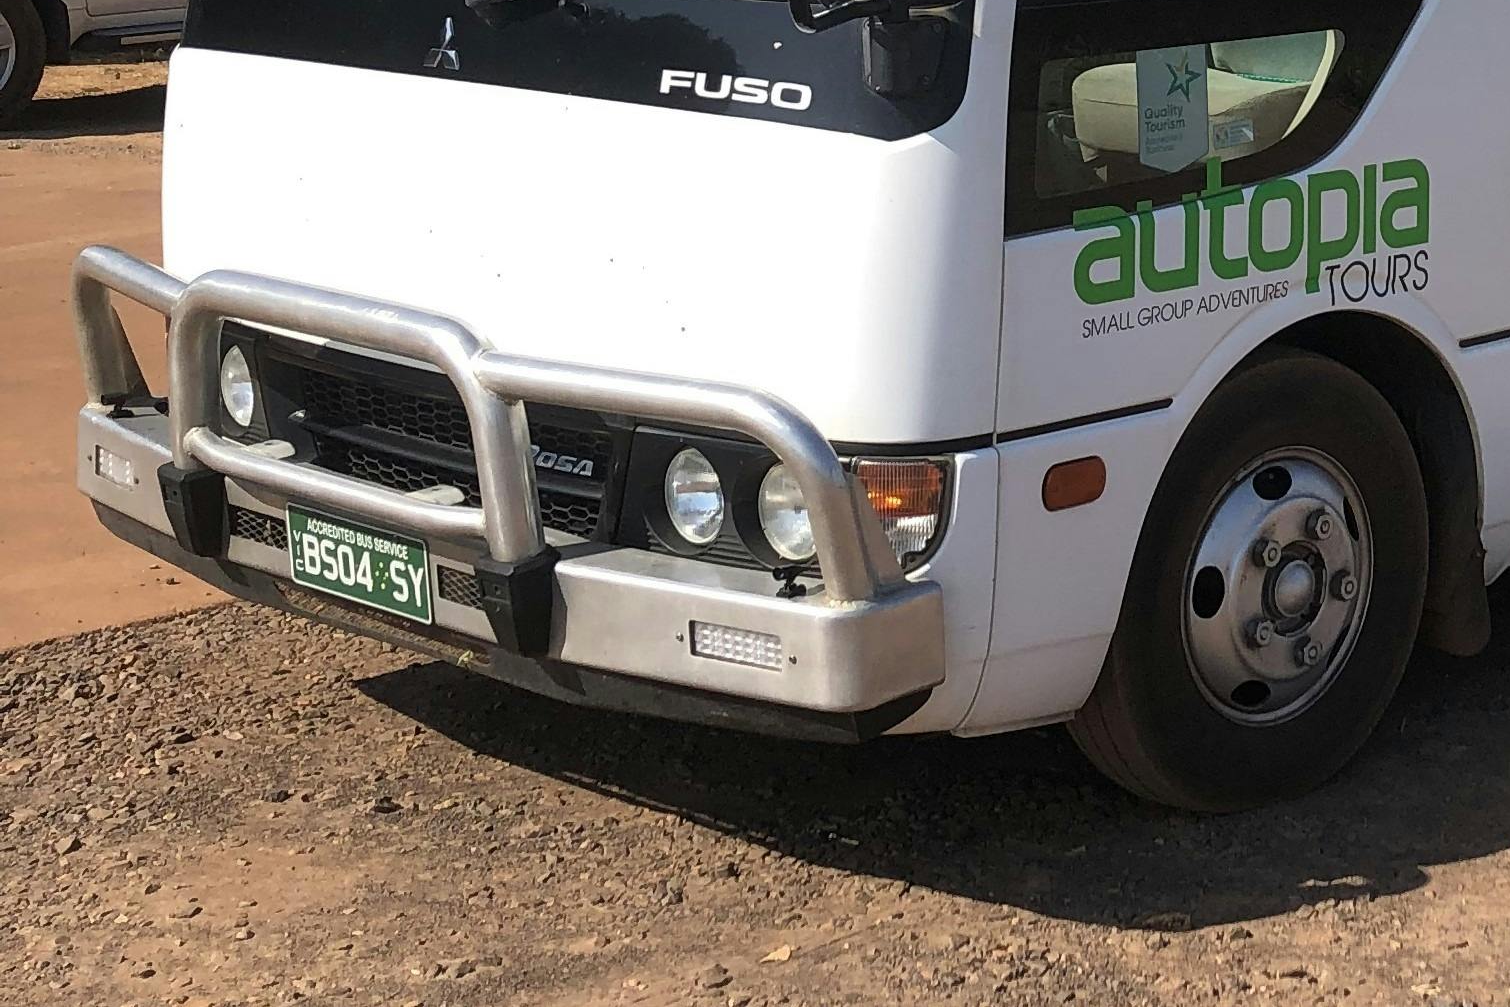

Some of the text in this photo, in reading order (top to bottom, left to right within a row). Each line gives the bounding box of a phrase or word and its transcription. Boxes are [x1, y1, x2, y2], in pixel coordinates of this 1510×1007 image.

[659, 69, 813, 111] FUSO
[1144, 104, 1183, 120] Quality
[1144, 118, 1186, 133] Tourism
[1073, 156, 1430, 306] autopia
[1324, 249, 1430, 307] TOURS
[1082, 280, 1289, 339] SMALL GROUP ADVENTURES
[292, 529, 305, 572] VIC
[306, 517, 409, 561] ACCREDITED BUS SERVICE
[389, 559, 424, 608] SY
